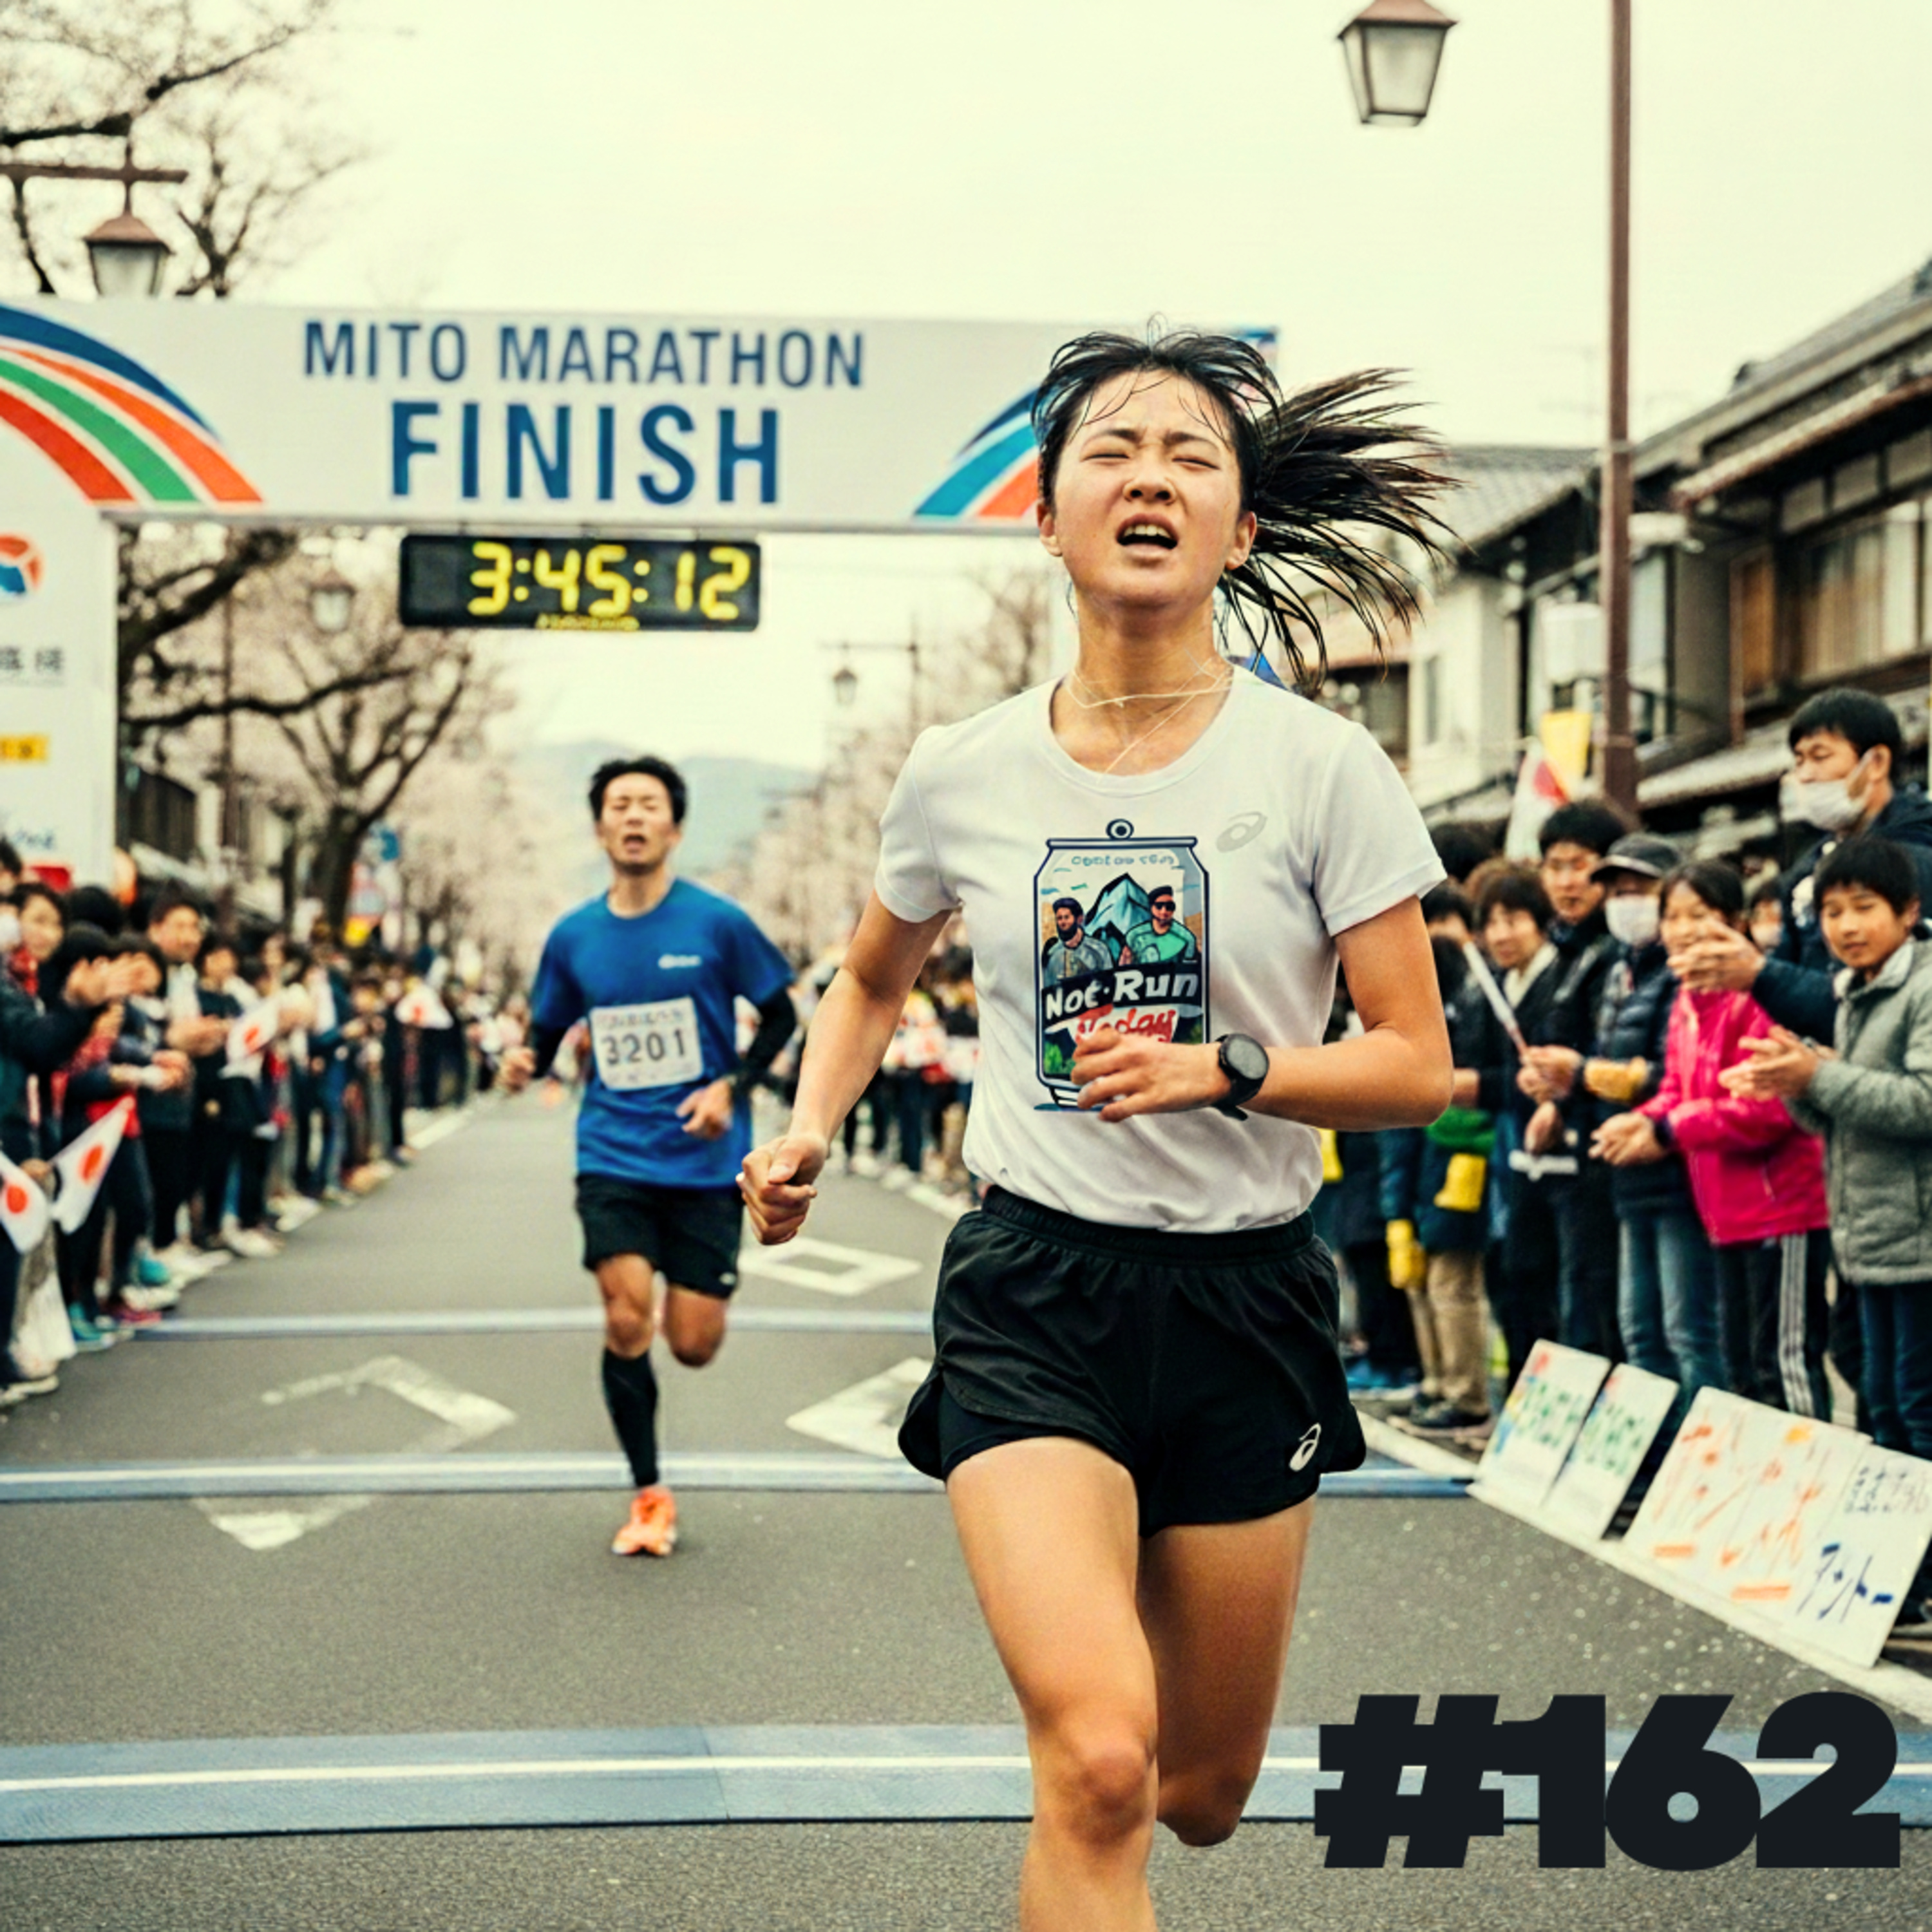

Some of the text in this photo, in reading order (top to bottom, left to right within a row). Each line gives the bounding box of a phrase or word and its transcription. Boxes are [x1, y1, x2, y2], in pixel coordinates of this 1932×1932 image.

[304, 321, 864, 388] MITO MARATHON
[391, 401, 779, 506] FINISH
[468, 540, 751, 621] 3:45:12
[1113, 969, 1198, 1002] Run
[601, 1027, 685, 1065] 3201
